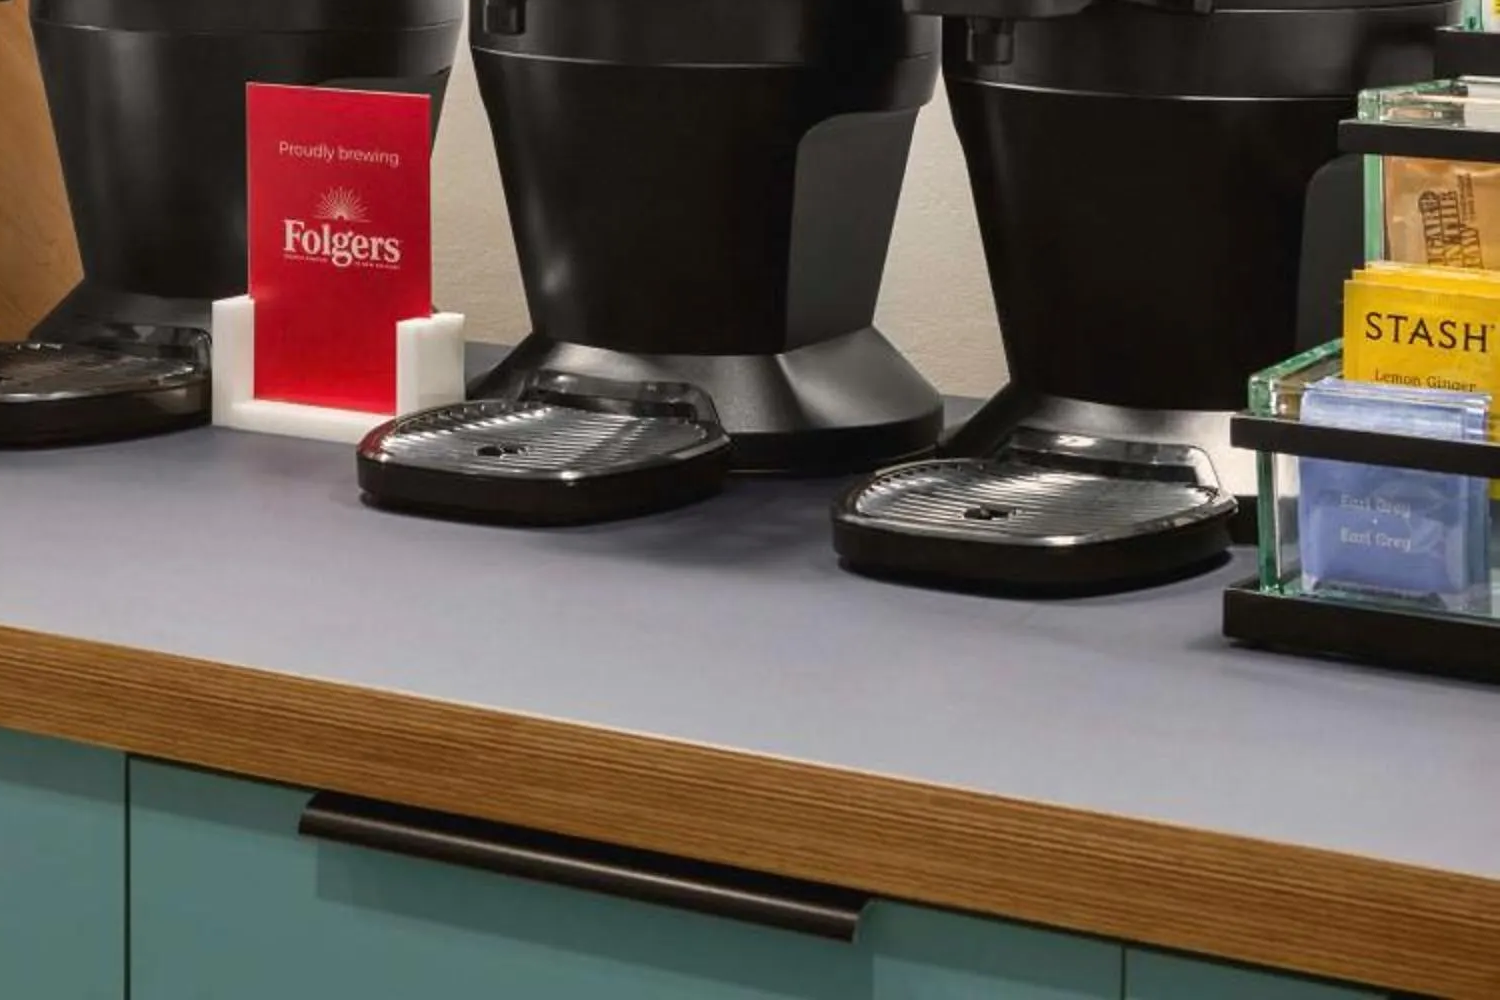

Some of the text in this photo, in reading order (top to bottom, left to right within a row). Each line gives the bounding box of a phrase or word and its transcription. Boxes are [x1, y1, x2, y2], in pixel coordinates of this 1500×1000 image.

[279, 140, 400, 169] Proudly brewing
[283, 218, 401, 268] Folgers
[1364, 311, 1489, 353] STASH
[1373, 367, 1478, 393] Lemon Ginger
